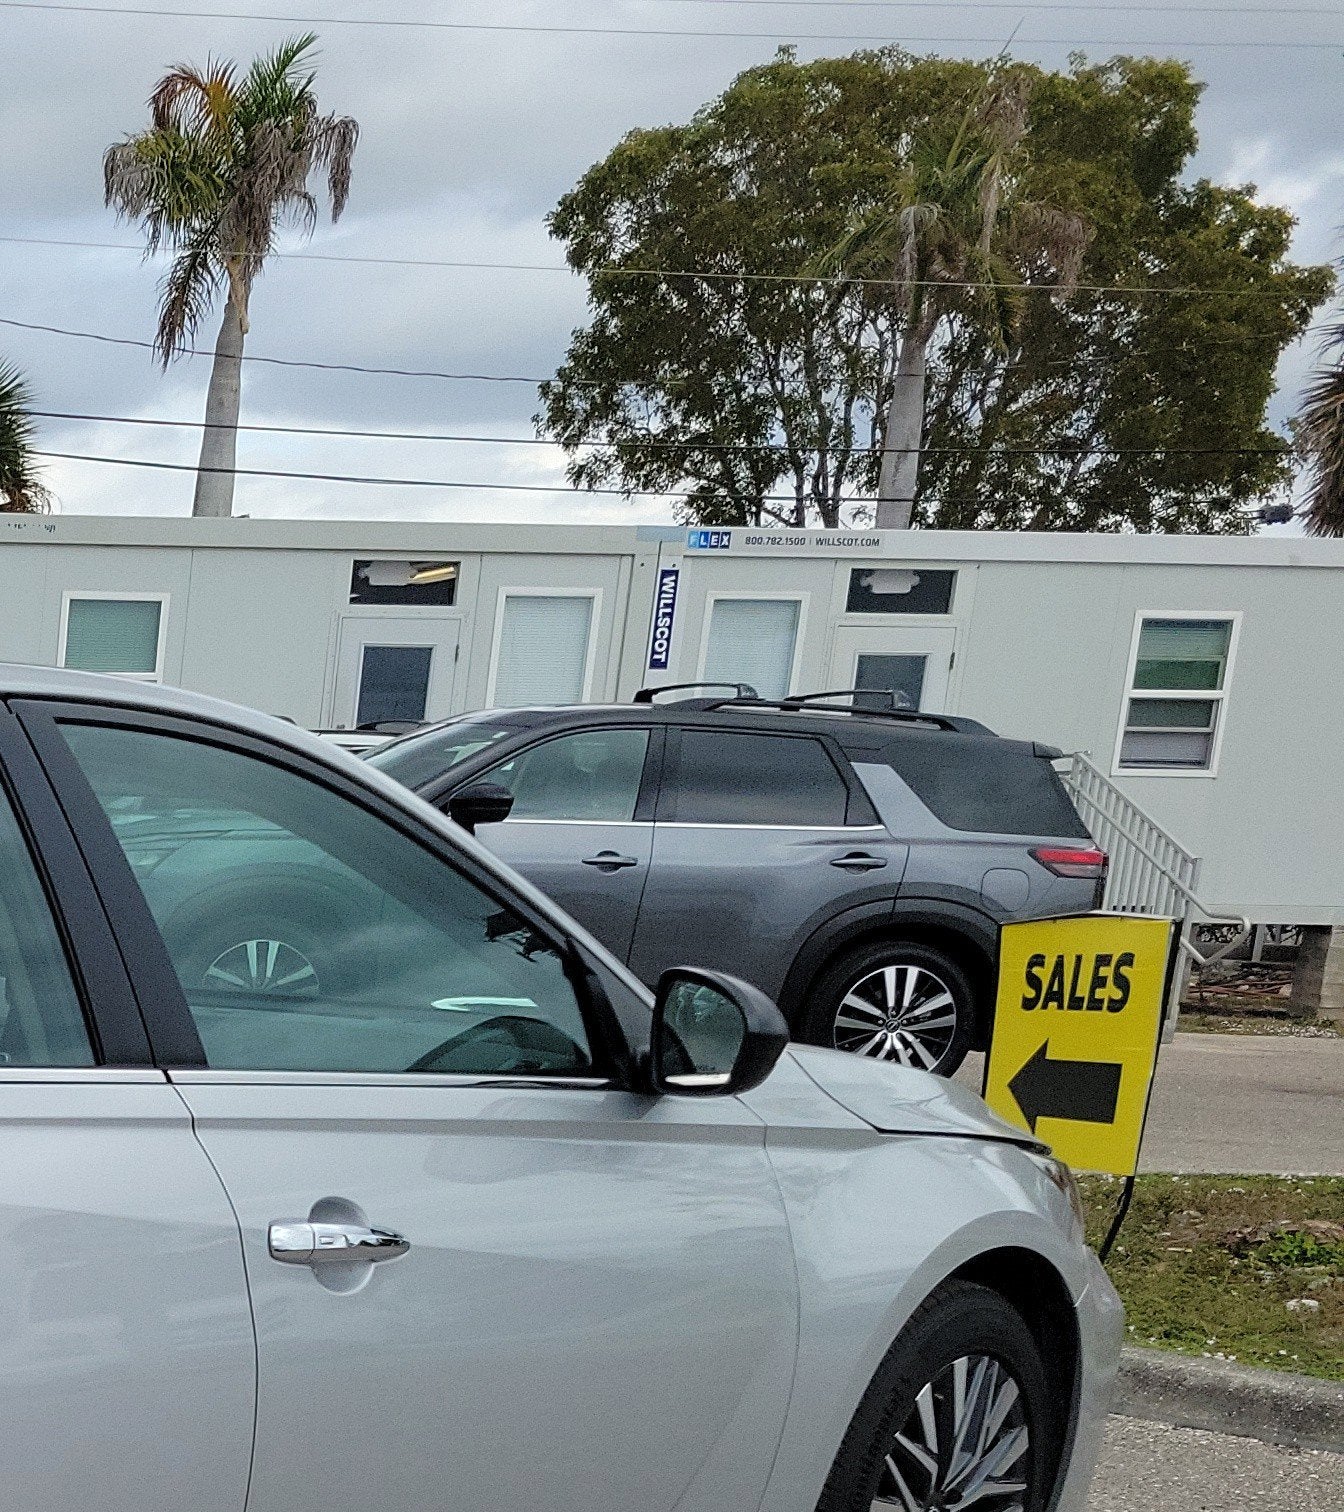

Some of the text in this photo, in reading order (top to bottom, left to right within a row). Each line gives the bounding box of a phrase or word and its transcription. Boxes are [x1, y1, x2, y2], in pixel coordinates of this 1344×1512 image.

[688, 531, 731, 549] FLEX
[744, 535, 880, 548] 800.782.1500 WILLSCOT.COM
[651, 574, 677, 663] WILLSCOT
[1020, 951, 1136, 1014] SALES
